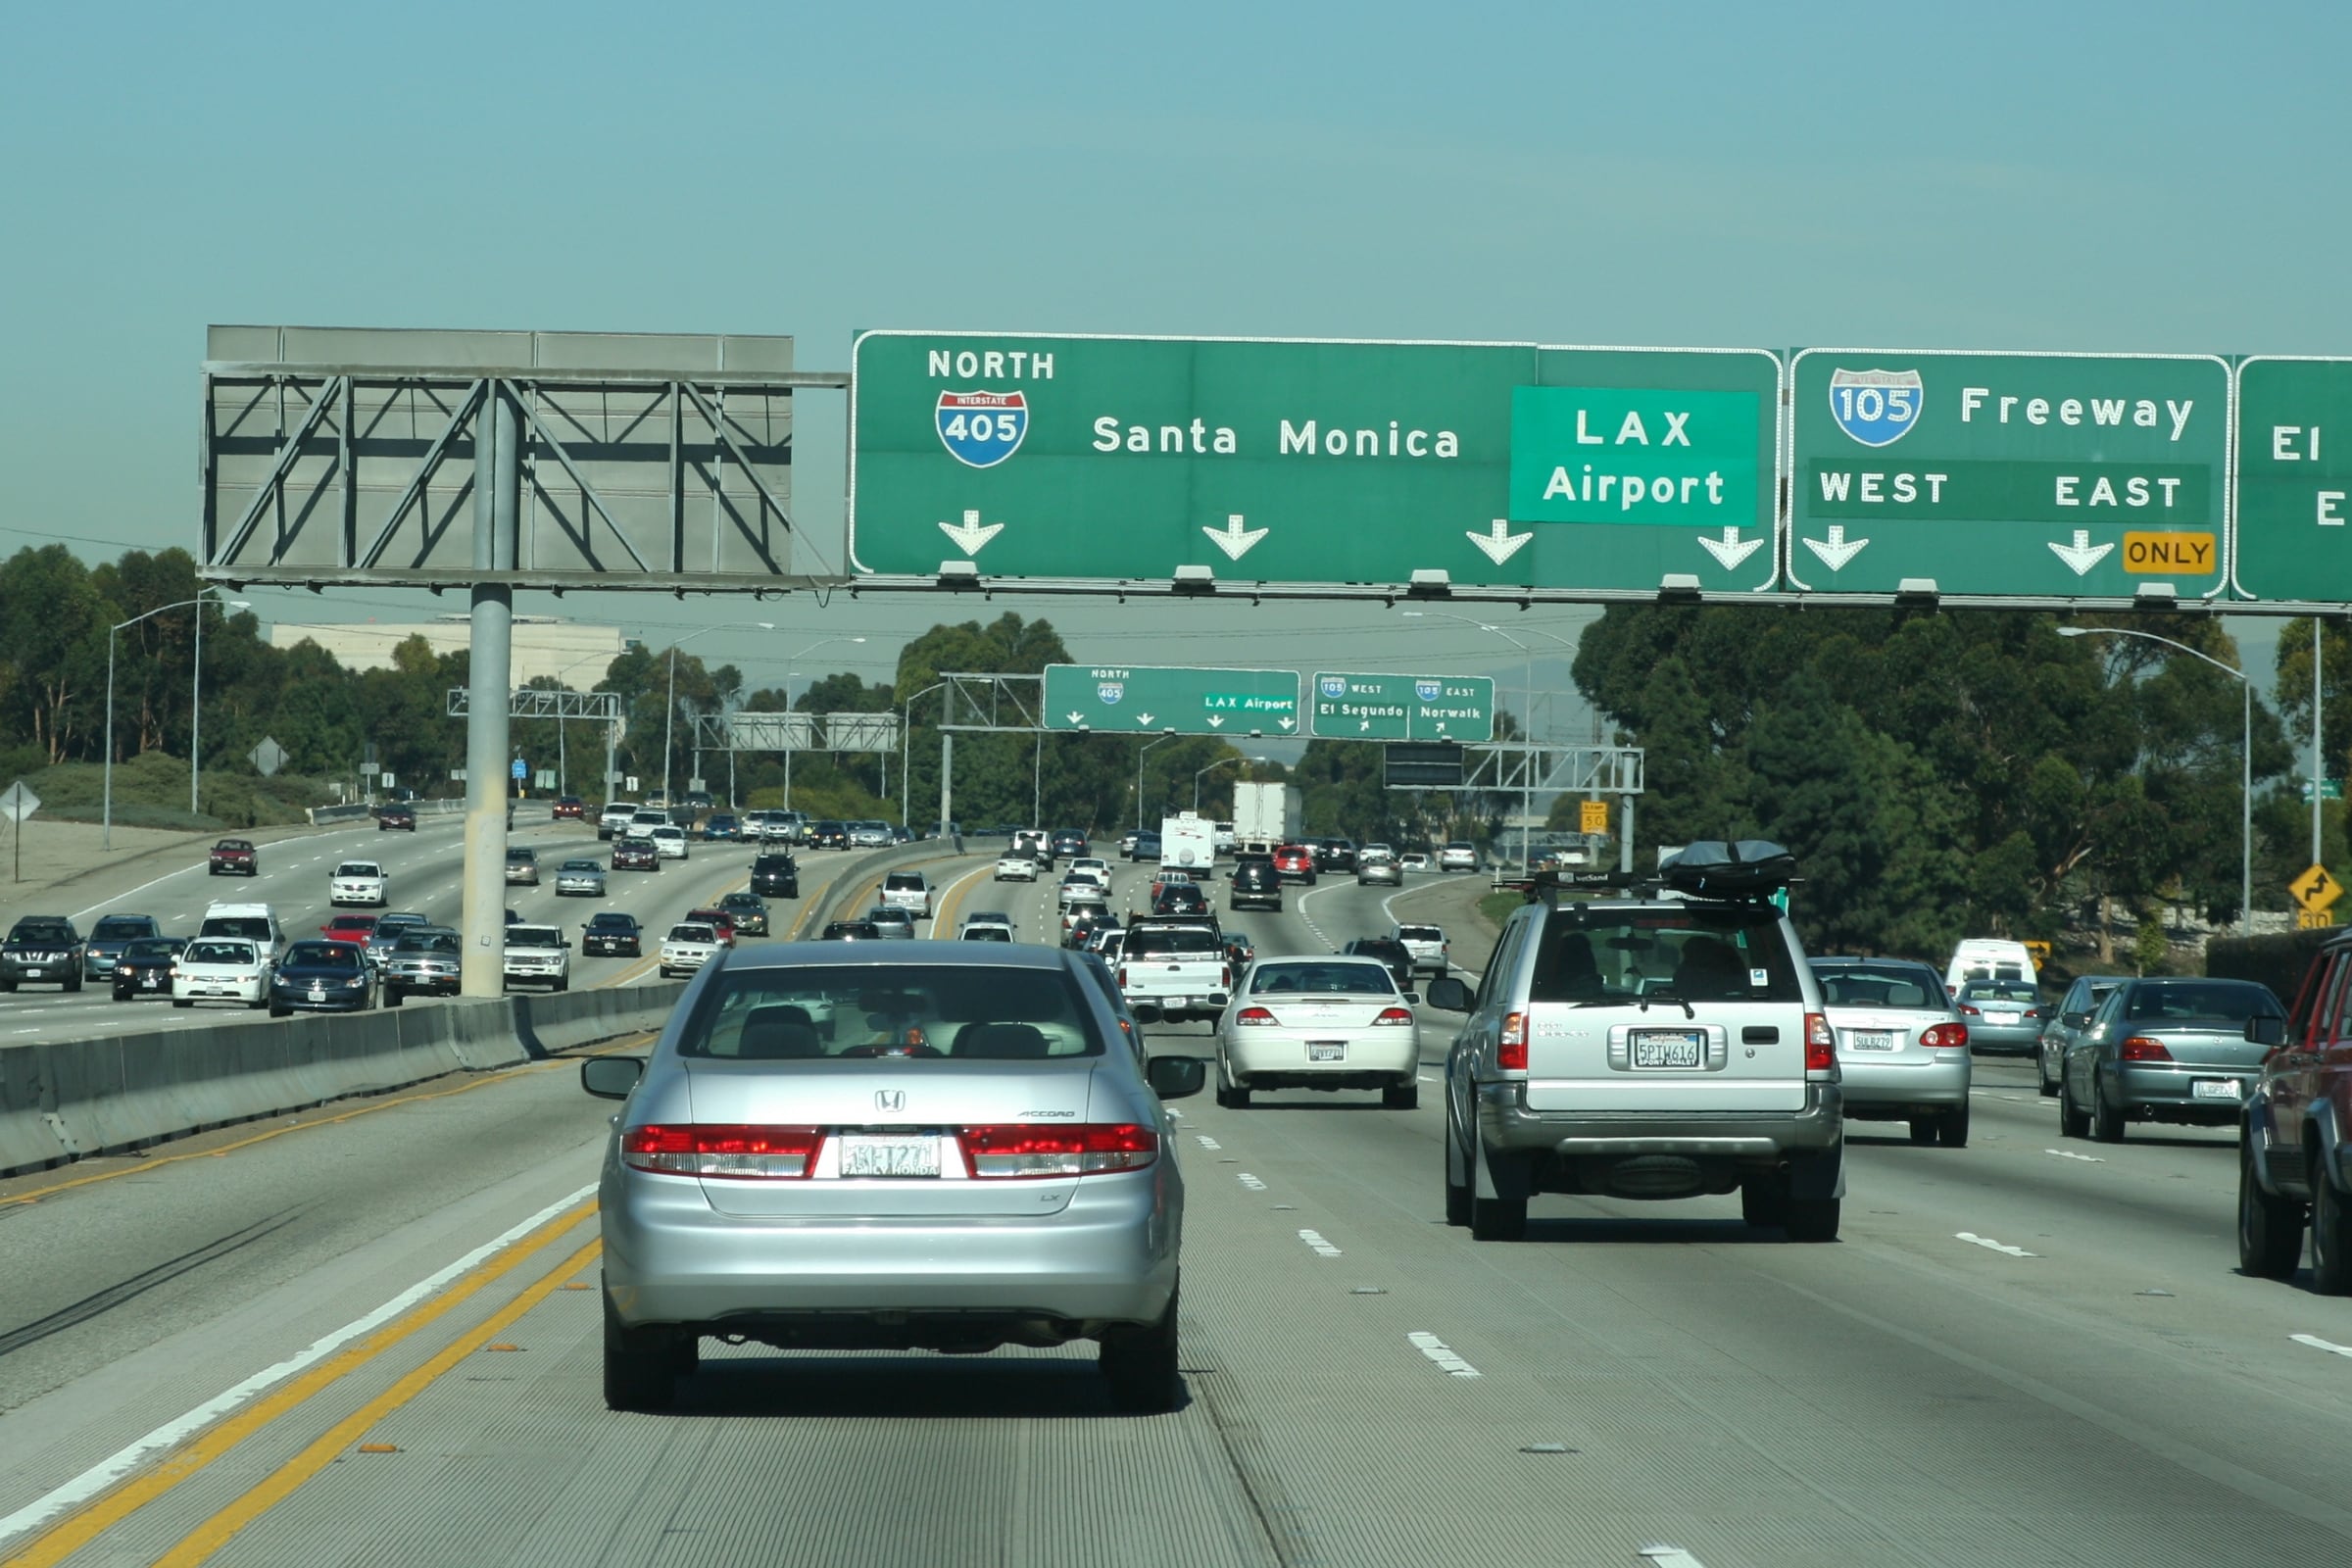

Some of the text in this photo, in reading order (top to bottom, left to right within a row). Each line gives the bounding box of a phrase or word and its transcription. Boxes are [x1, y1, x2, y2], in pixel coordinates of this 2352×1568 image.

[928, 350, 1054, 379] NORTH
[956, 396, 1007, 405] INTERSTATE
[1839, 388, 1912, 422] 105
[1961, 387, 2193, 442] Freeway
[945, 414, 1017, 442] 405
[1092, 416, 1458, 459] Santa Monica
[1576, 409, 1691, 447] LAX
[2273, 425, 2320, 462] El
[1543, 464, 1724, 512] Airport
[1820, 471, 1948, 504] WEST
[2055, 476, 2180, 508] EAST
[2128, 541, 2211, 564] ONLY
[1091, 669, 1130, 679] NORTH
[1100, 688, 1121, 699] 405
[1323, 682, 1382, 694] 105 WEST
[1419, 686, 1475, 697] 105 EAST
[1204, 697, 1294, 711] LAX Airport
[1320, 703, 1403, 718] El Segundo
[1420, 706, 1481, 719] Norwalk
[1586, 815, 1603, 827] 50
[841, 1166, 938, 1175] FAMILY HONDA
